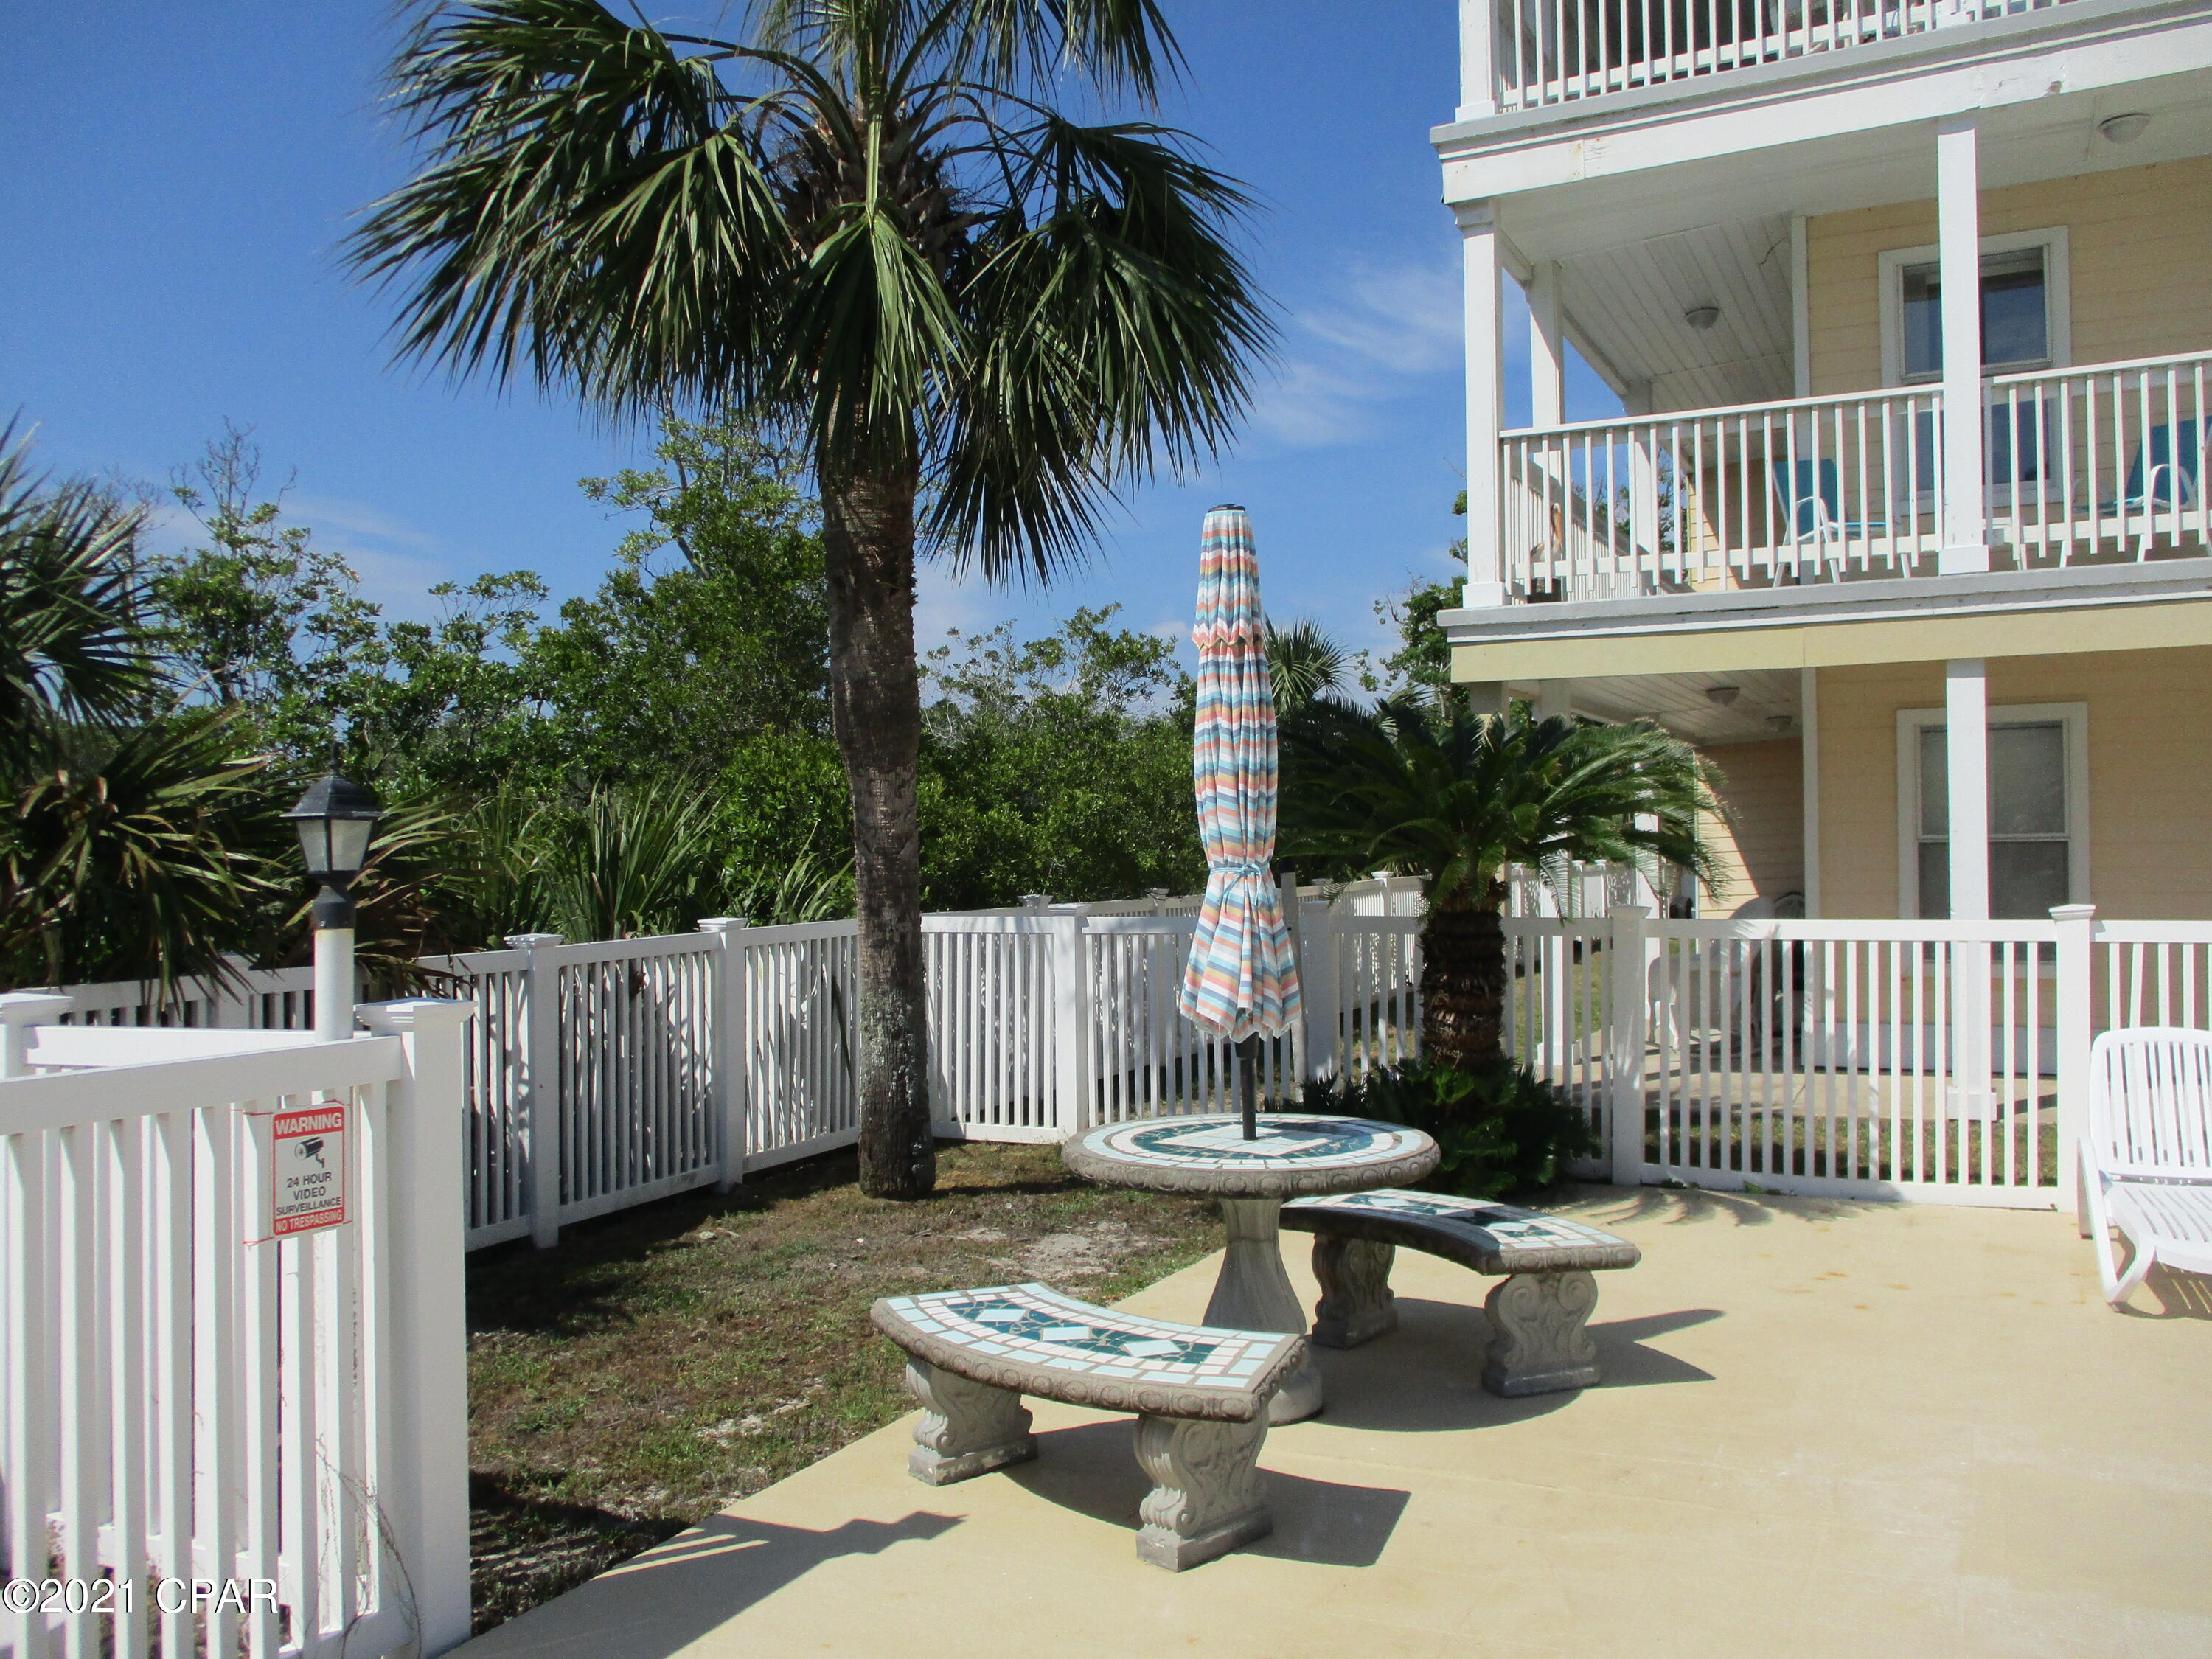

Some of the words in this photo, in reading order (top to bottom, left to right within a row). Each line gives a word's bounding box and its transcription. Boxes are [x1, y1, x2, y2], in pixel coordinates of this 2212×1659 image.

[275, 1112, 343, 1135] WARNING
[287, 1176, 299, 1188] 24
[303, 1172, 332, 1186] HOUR
[293, 1186, 326, 1200] VIDEO
[276, 1197, 341, 1216] SURVEILLANCE
[276, 1218, 288, 1232] NO
[290, 1210, 342, 1230] TRESPASSING
